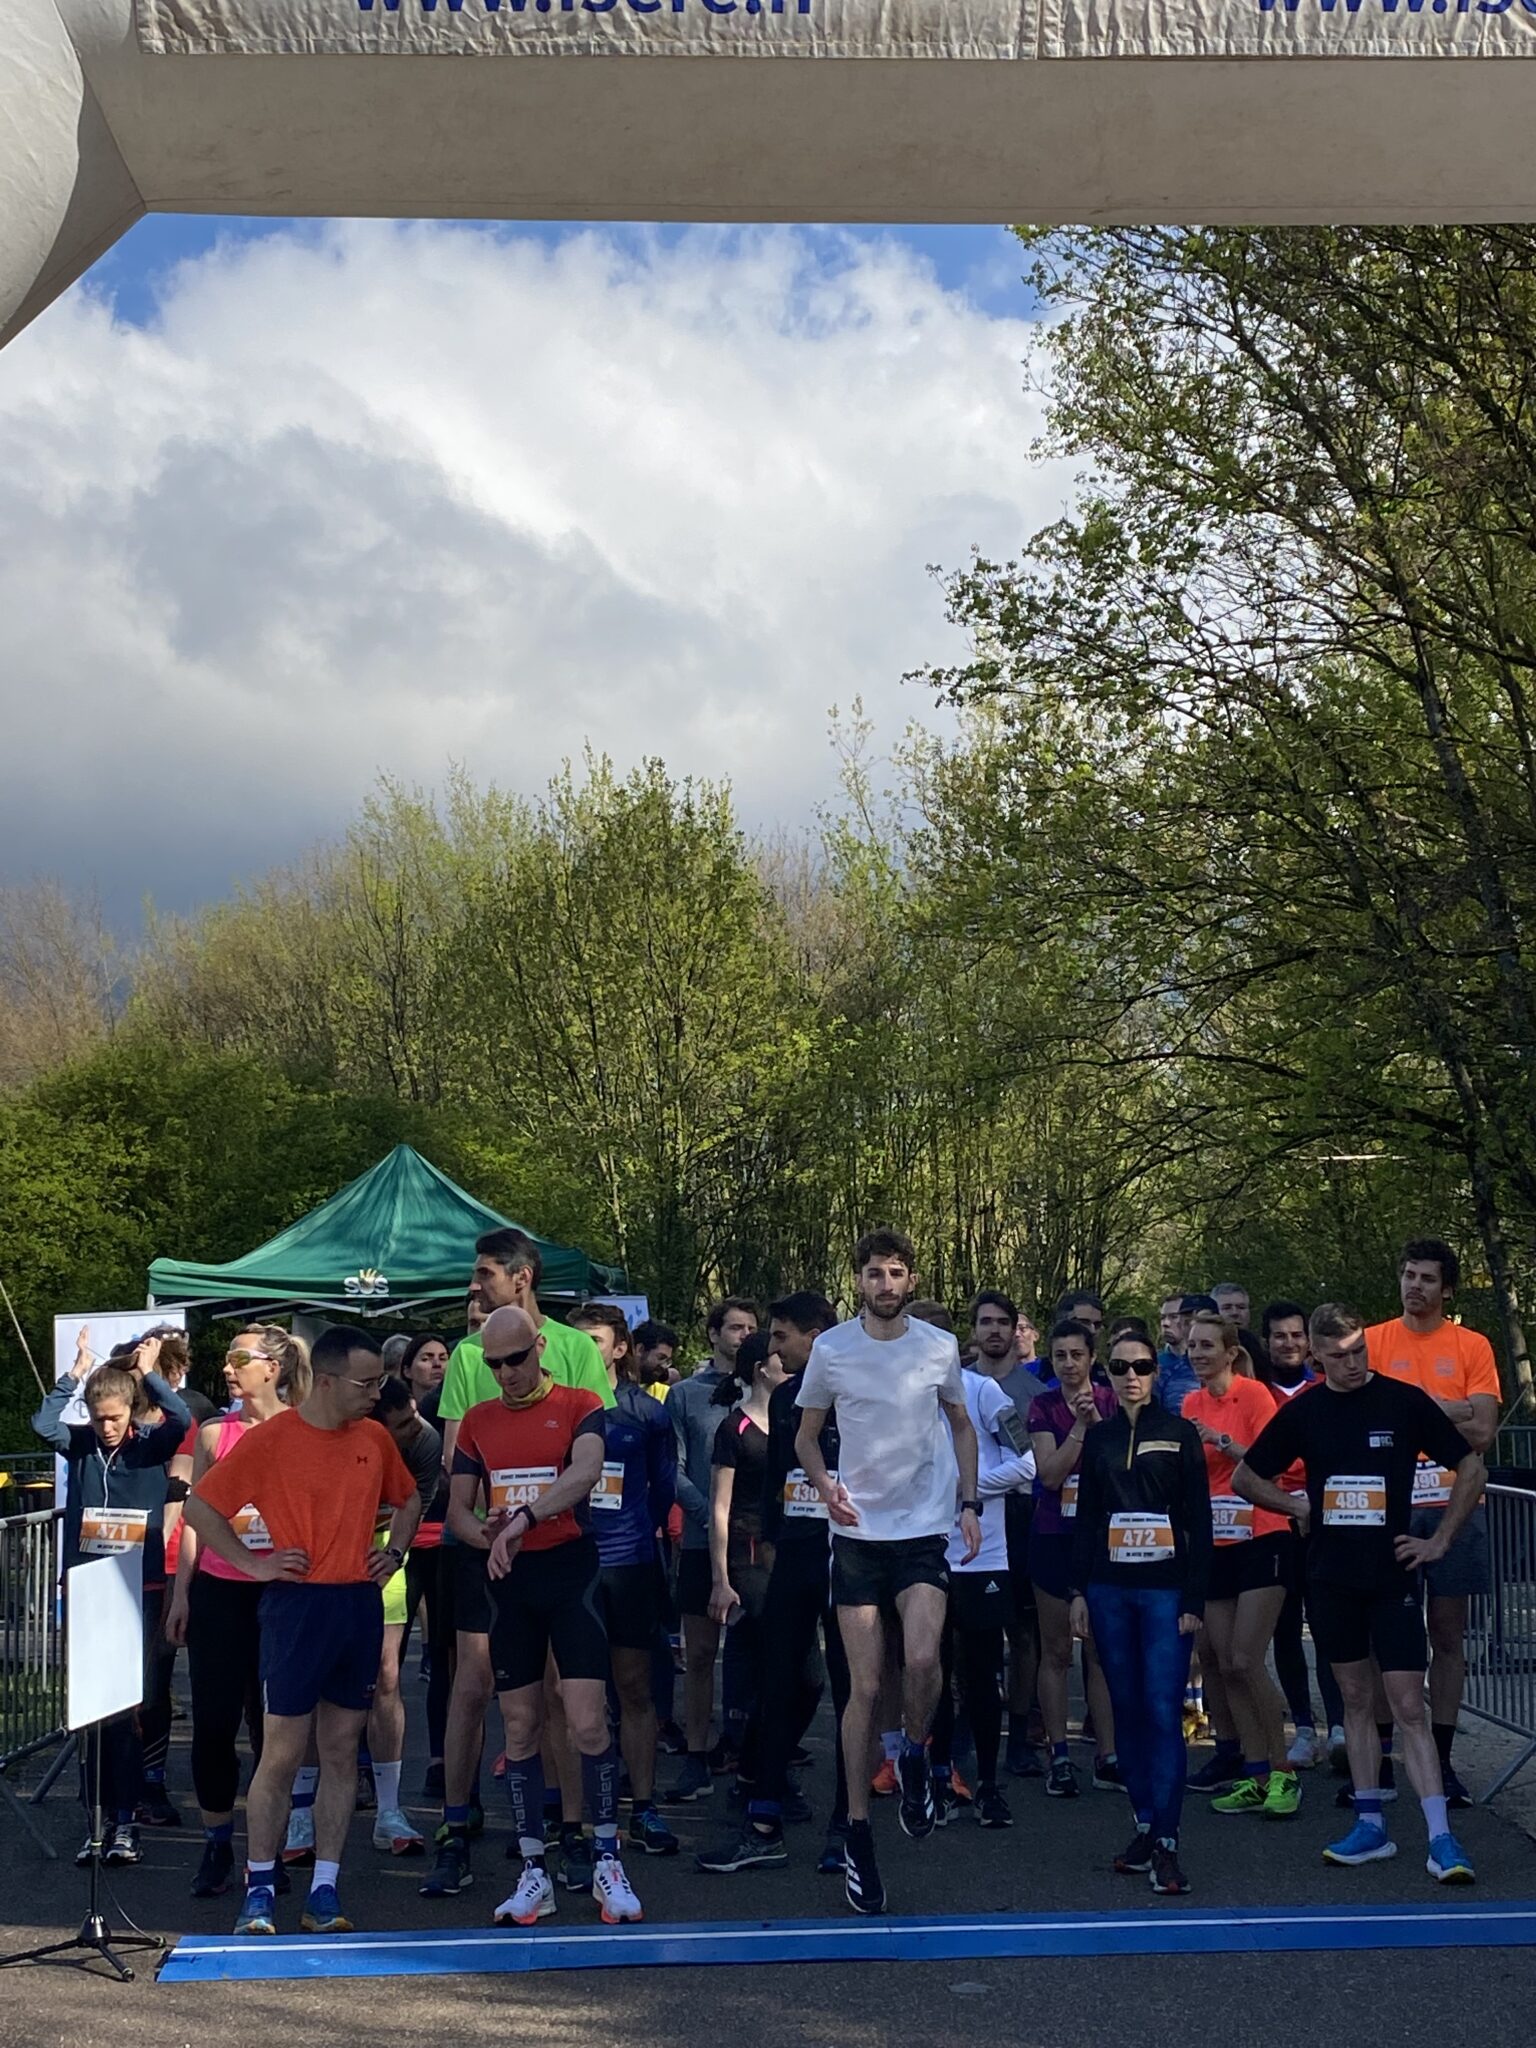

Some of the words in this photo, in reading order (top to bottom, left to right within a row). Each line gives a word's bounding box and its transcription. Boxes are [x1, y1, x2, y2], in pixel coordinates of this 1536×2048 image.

[505, 1485, 540, 1504] 448
[793, 1483, 820, 1502] 430
[1336, 1492, 1370, 1509] 486
[1212, 1510, 1238, 1525] 387
[96, 1523, 128, 1540] 471
[1122, 1529, 1157, 1547] 472
